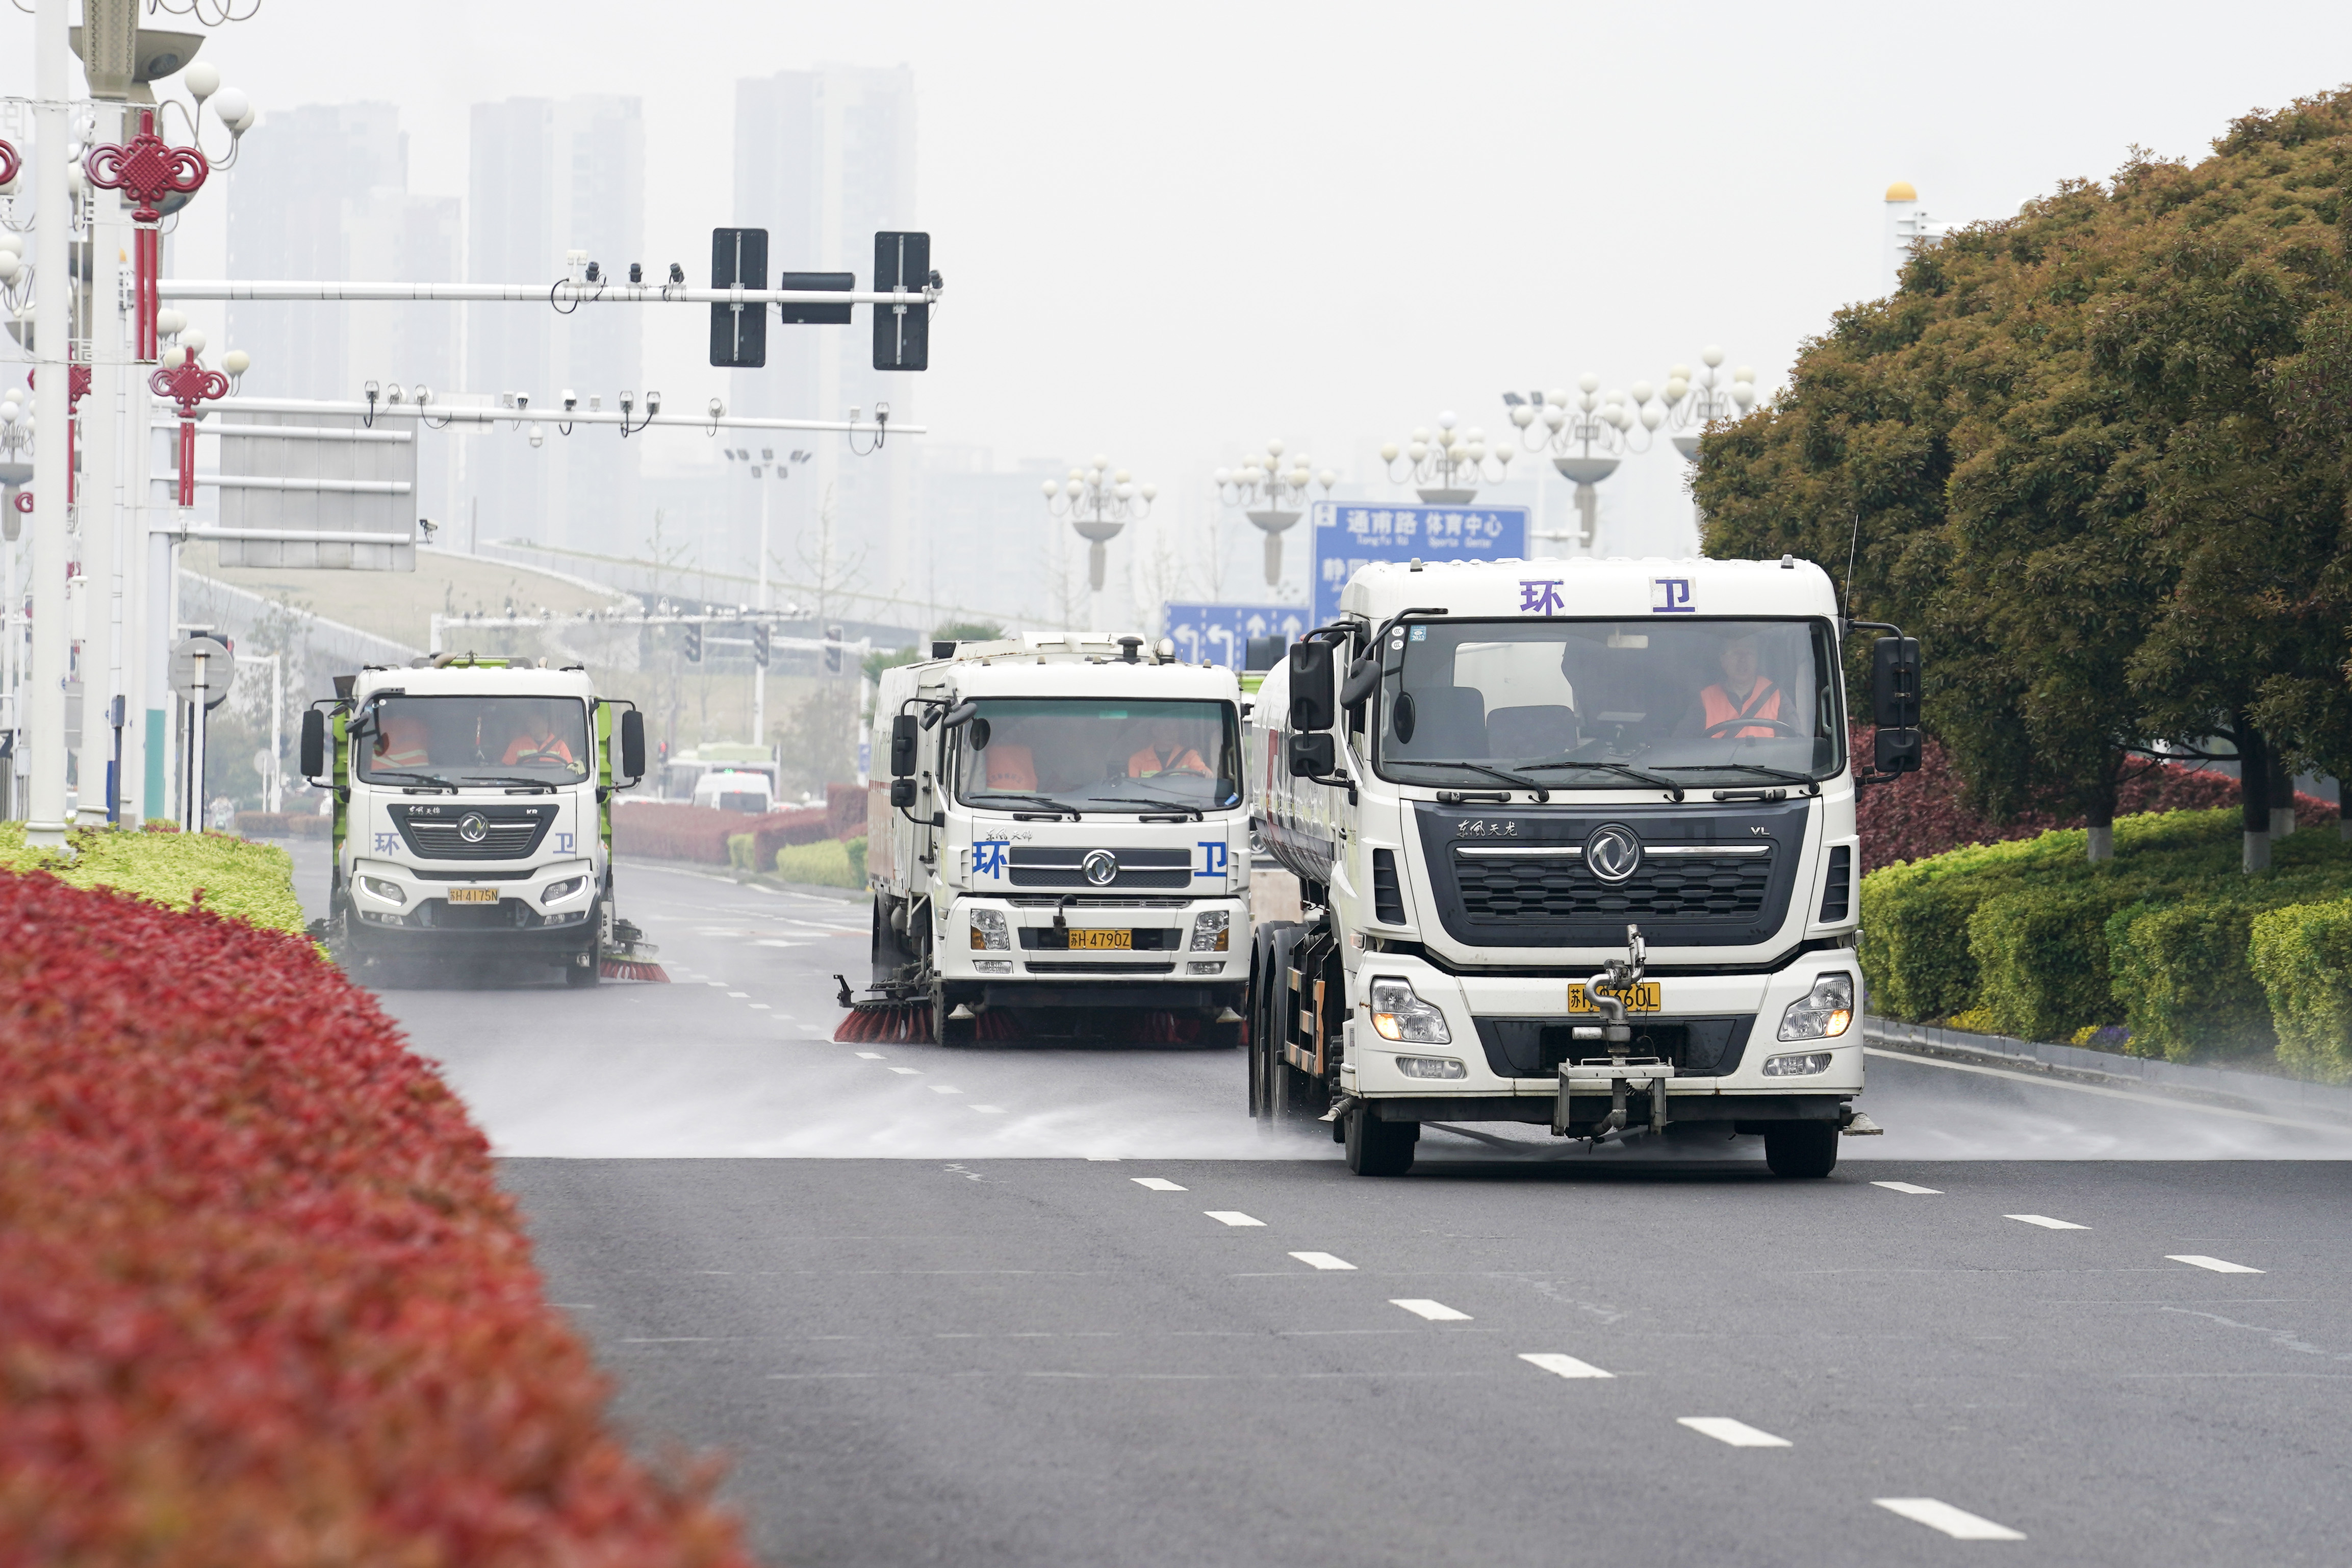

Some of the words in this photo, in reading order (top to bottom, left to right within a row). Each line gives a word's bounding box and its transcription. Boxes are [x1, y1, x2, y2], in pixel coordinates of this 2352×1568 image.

[1426, 512, 1503, 537] 体育中心
[1520, 580, 1565, 616] 环
[1653, 579, 1695, 612] 卫
[1456, 819, 1518, 838] 东风天龙
[1750, 827, 1770, 835] VL
[375, 833, 400, 856] 环
[553, 833, 576, 854] 卫
[974, 841, 1010, 879] 环
[1194, 842, 1228, 877] 卫
